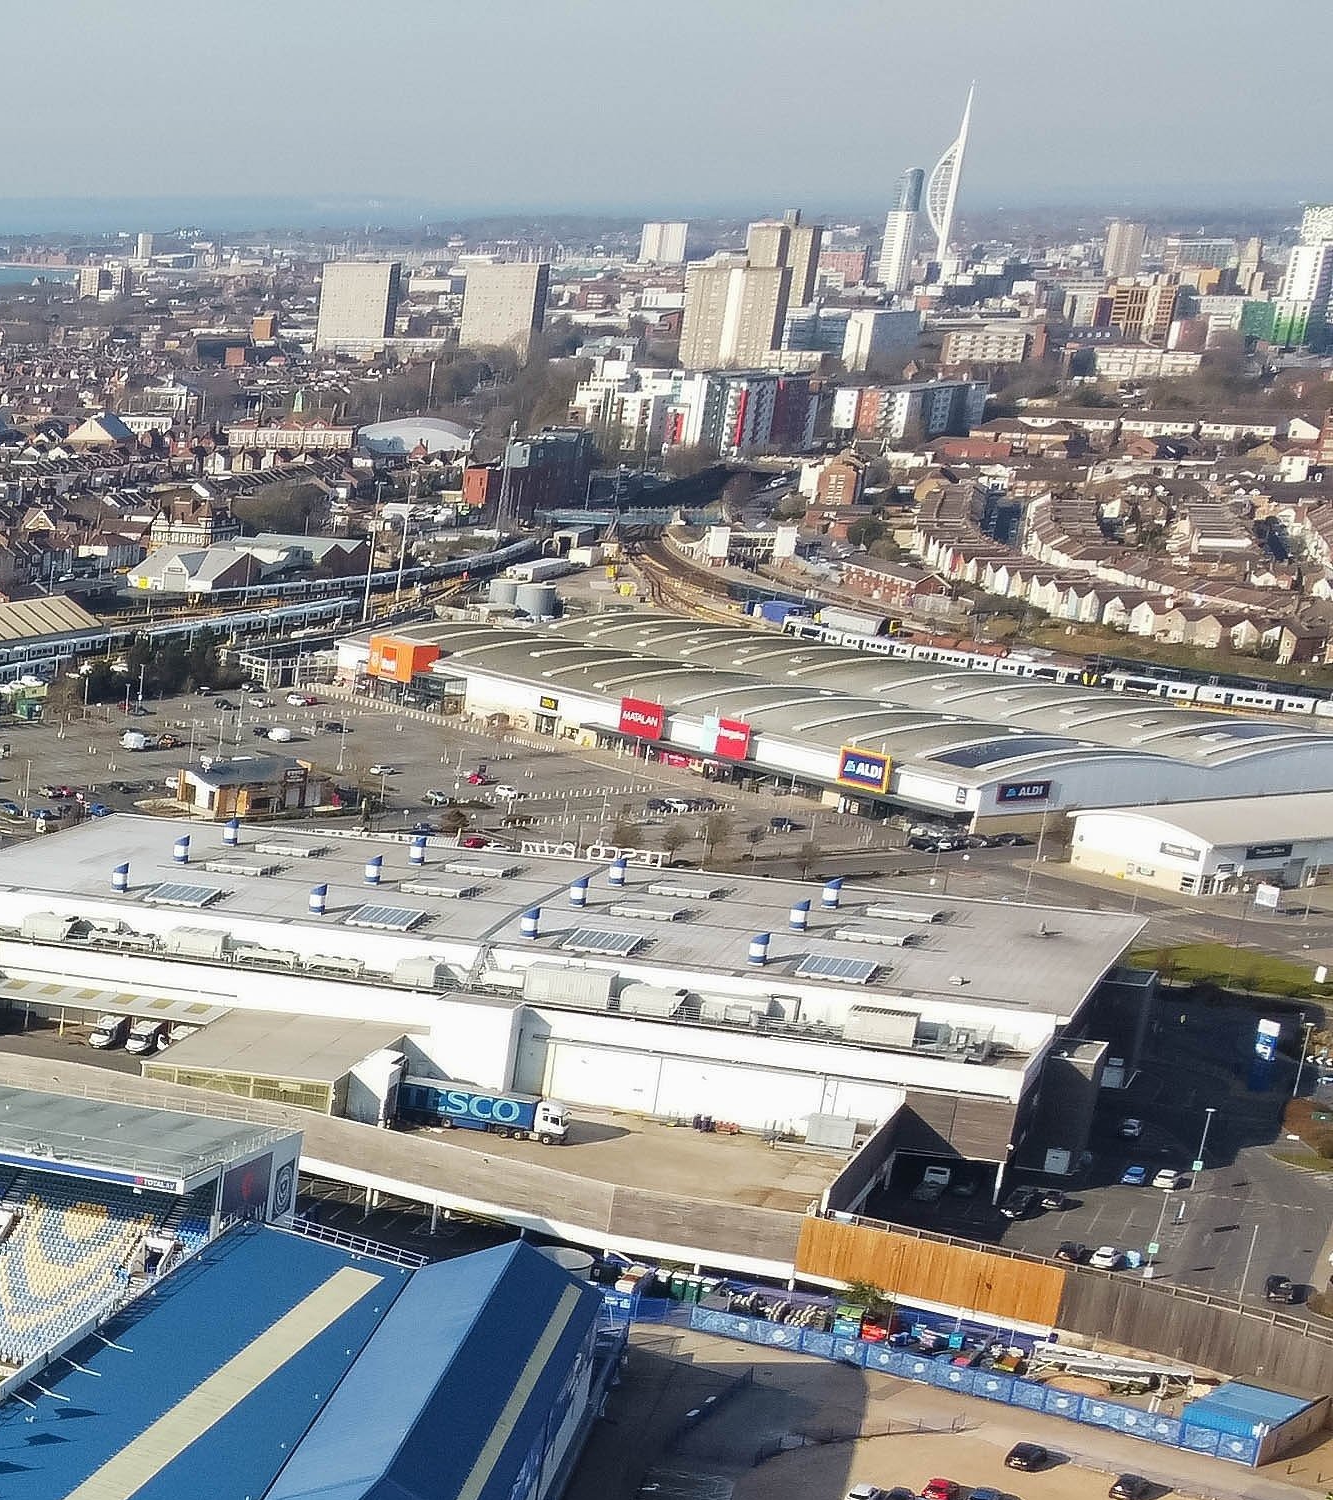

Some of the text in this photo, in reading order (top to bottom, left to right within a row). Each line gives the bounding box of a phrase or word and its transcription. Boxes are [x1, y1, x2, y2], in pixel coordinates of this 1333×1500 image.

[622, 710, 658, 728] MATALAN
[855, 762, 883, 780] ALDI
[1018, 785, 1043, 797] ALDI
